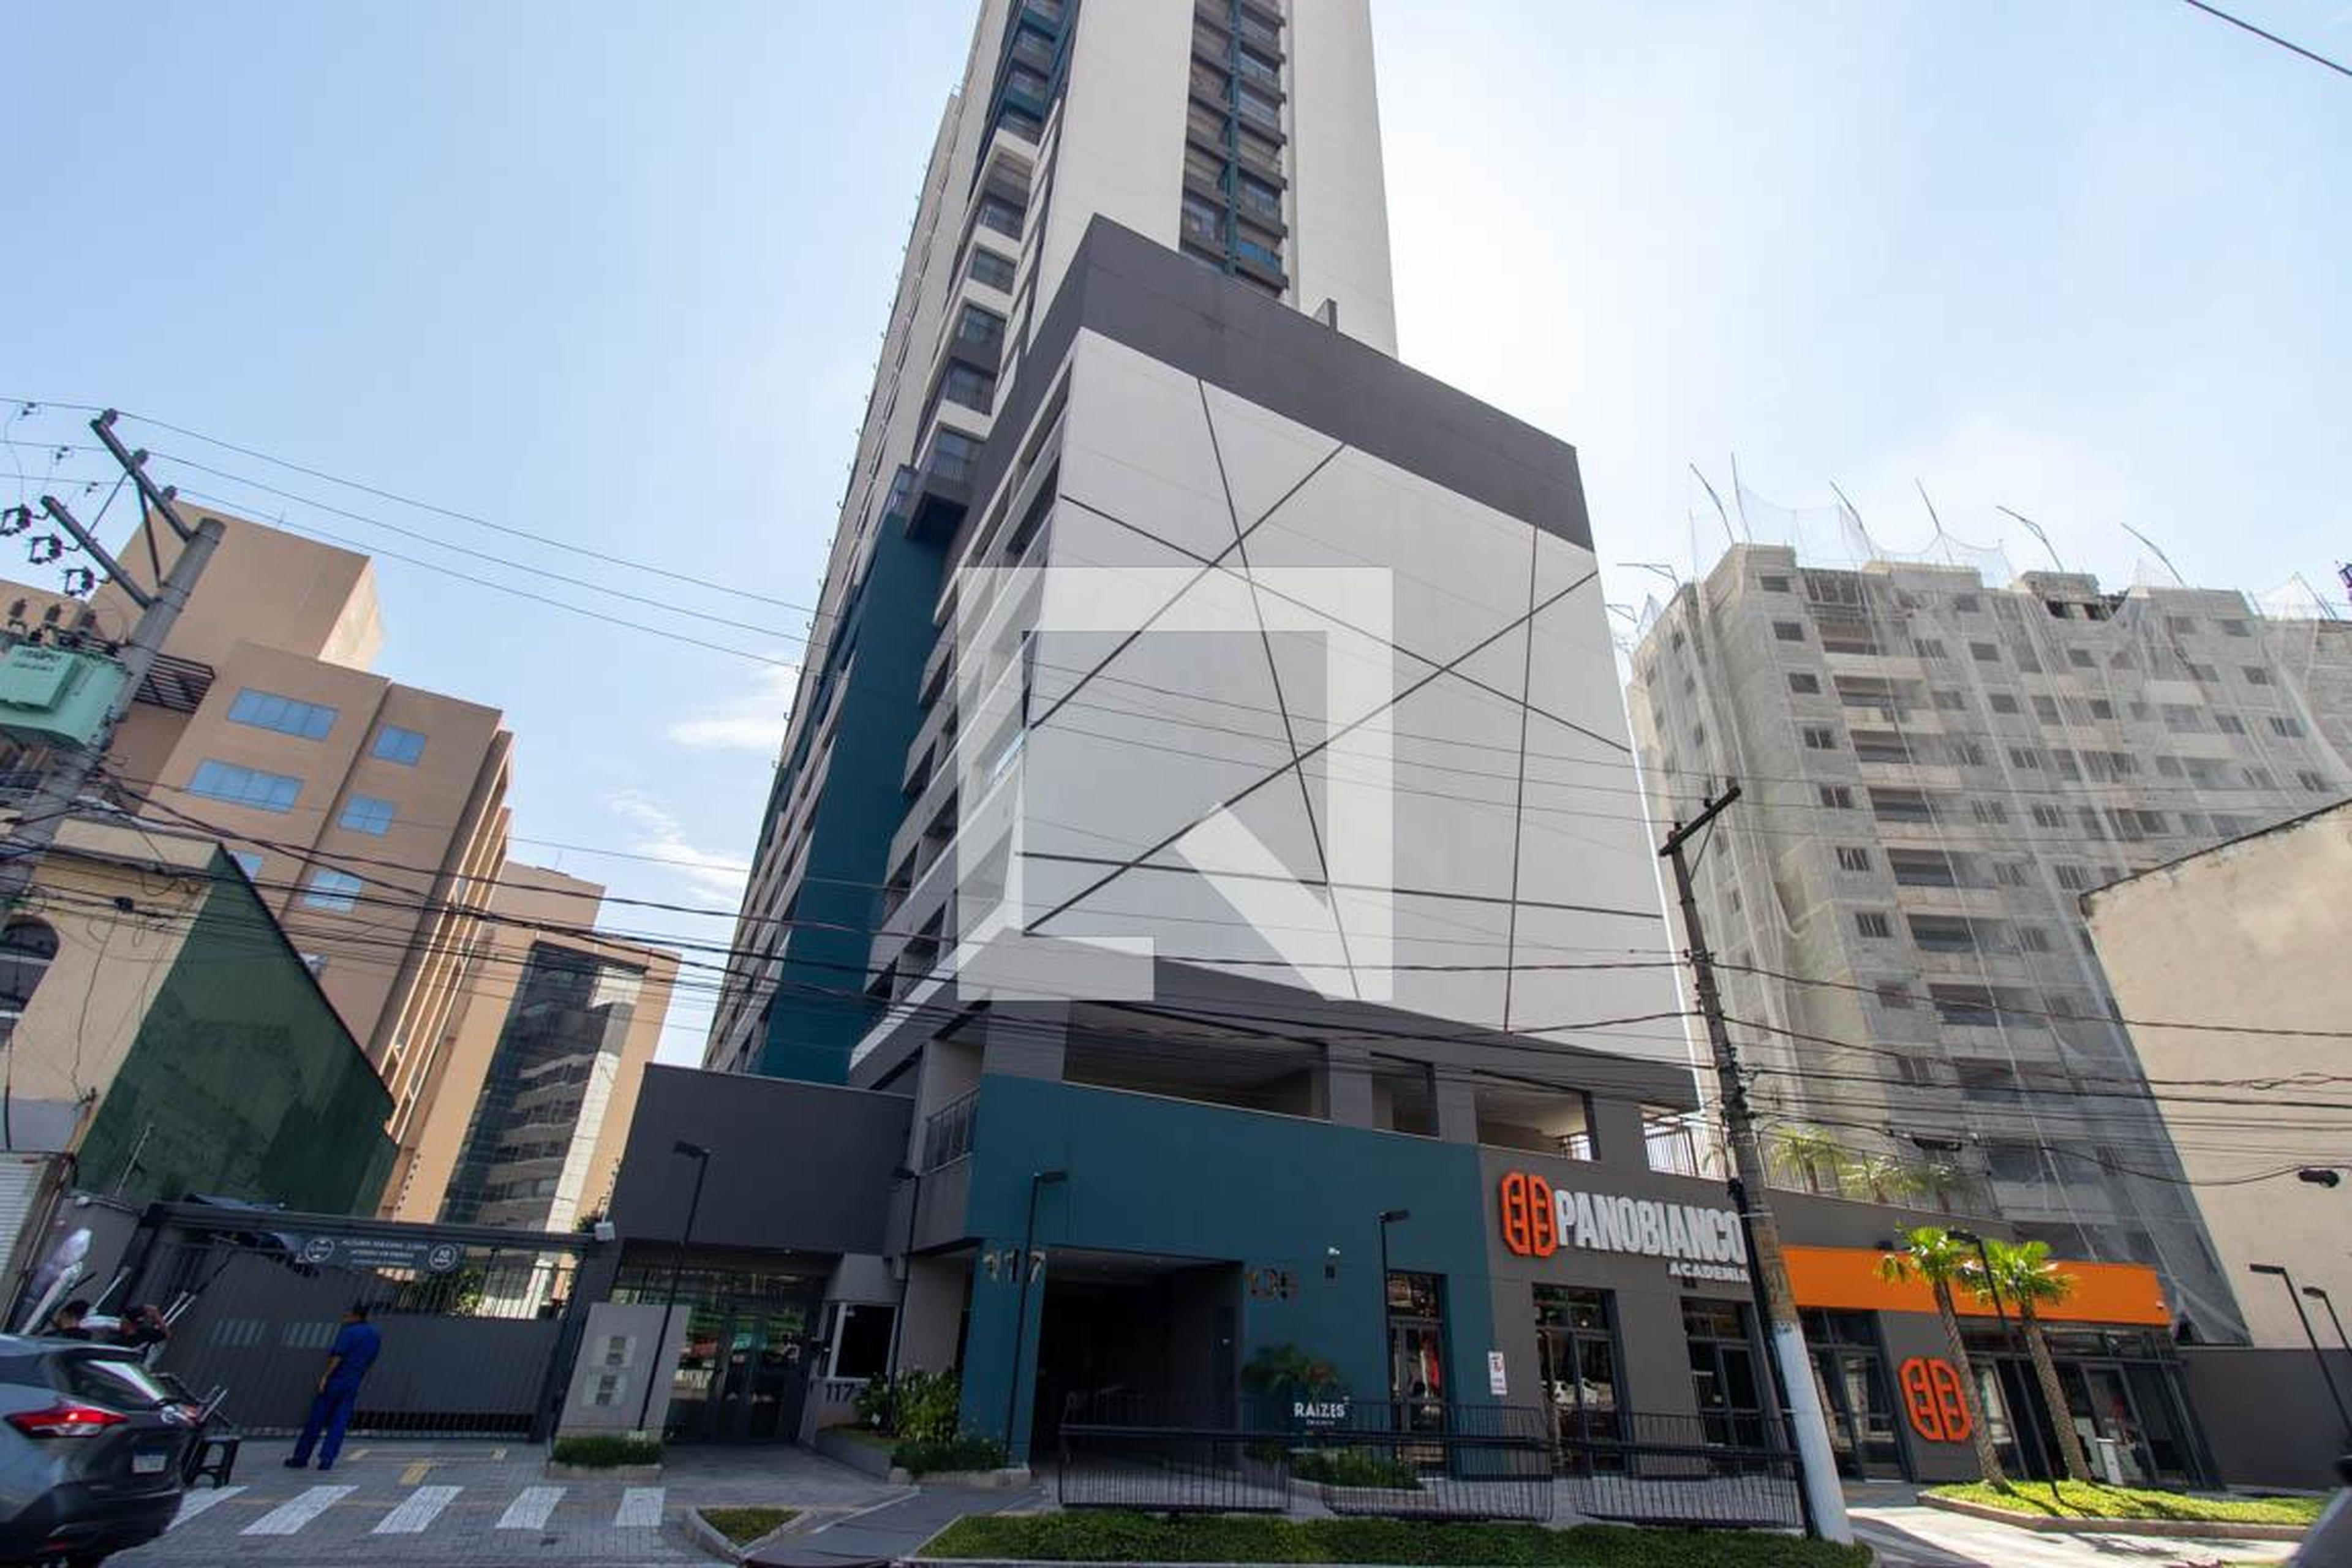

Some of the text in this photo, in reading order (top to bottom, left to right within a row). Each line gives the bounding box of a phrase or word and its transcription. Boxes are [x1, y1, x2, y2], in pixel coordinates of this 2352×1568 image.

[1554, 1189, 1747, 1264] PANOBIANCO
[1668, 1261, 1751, 1283] ACADEMIA
[826, 1382, 855, 1403] 117
